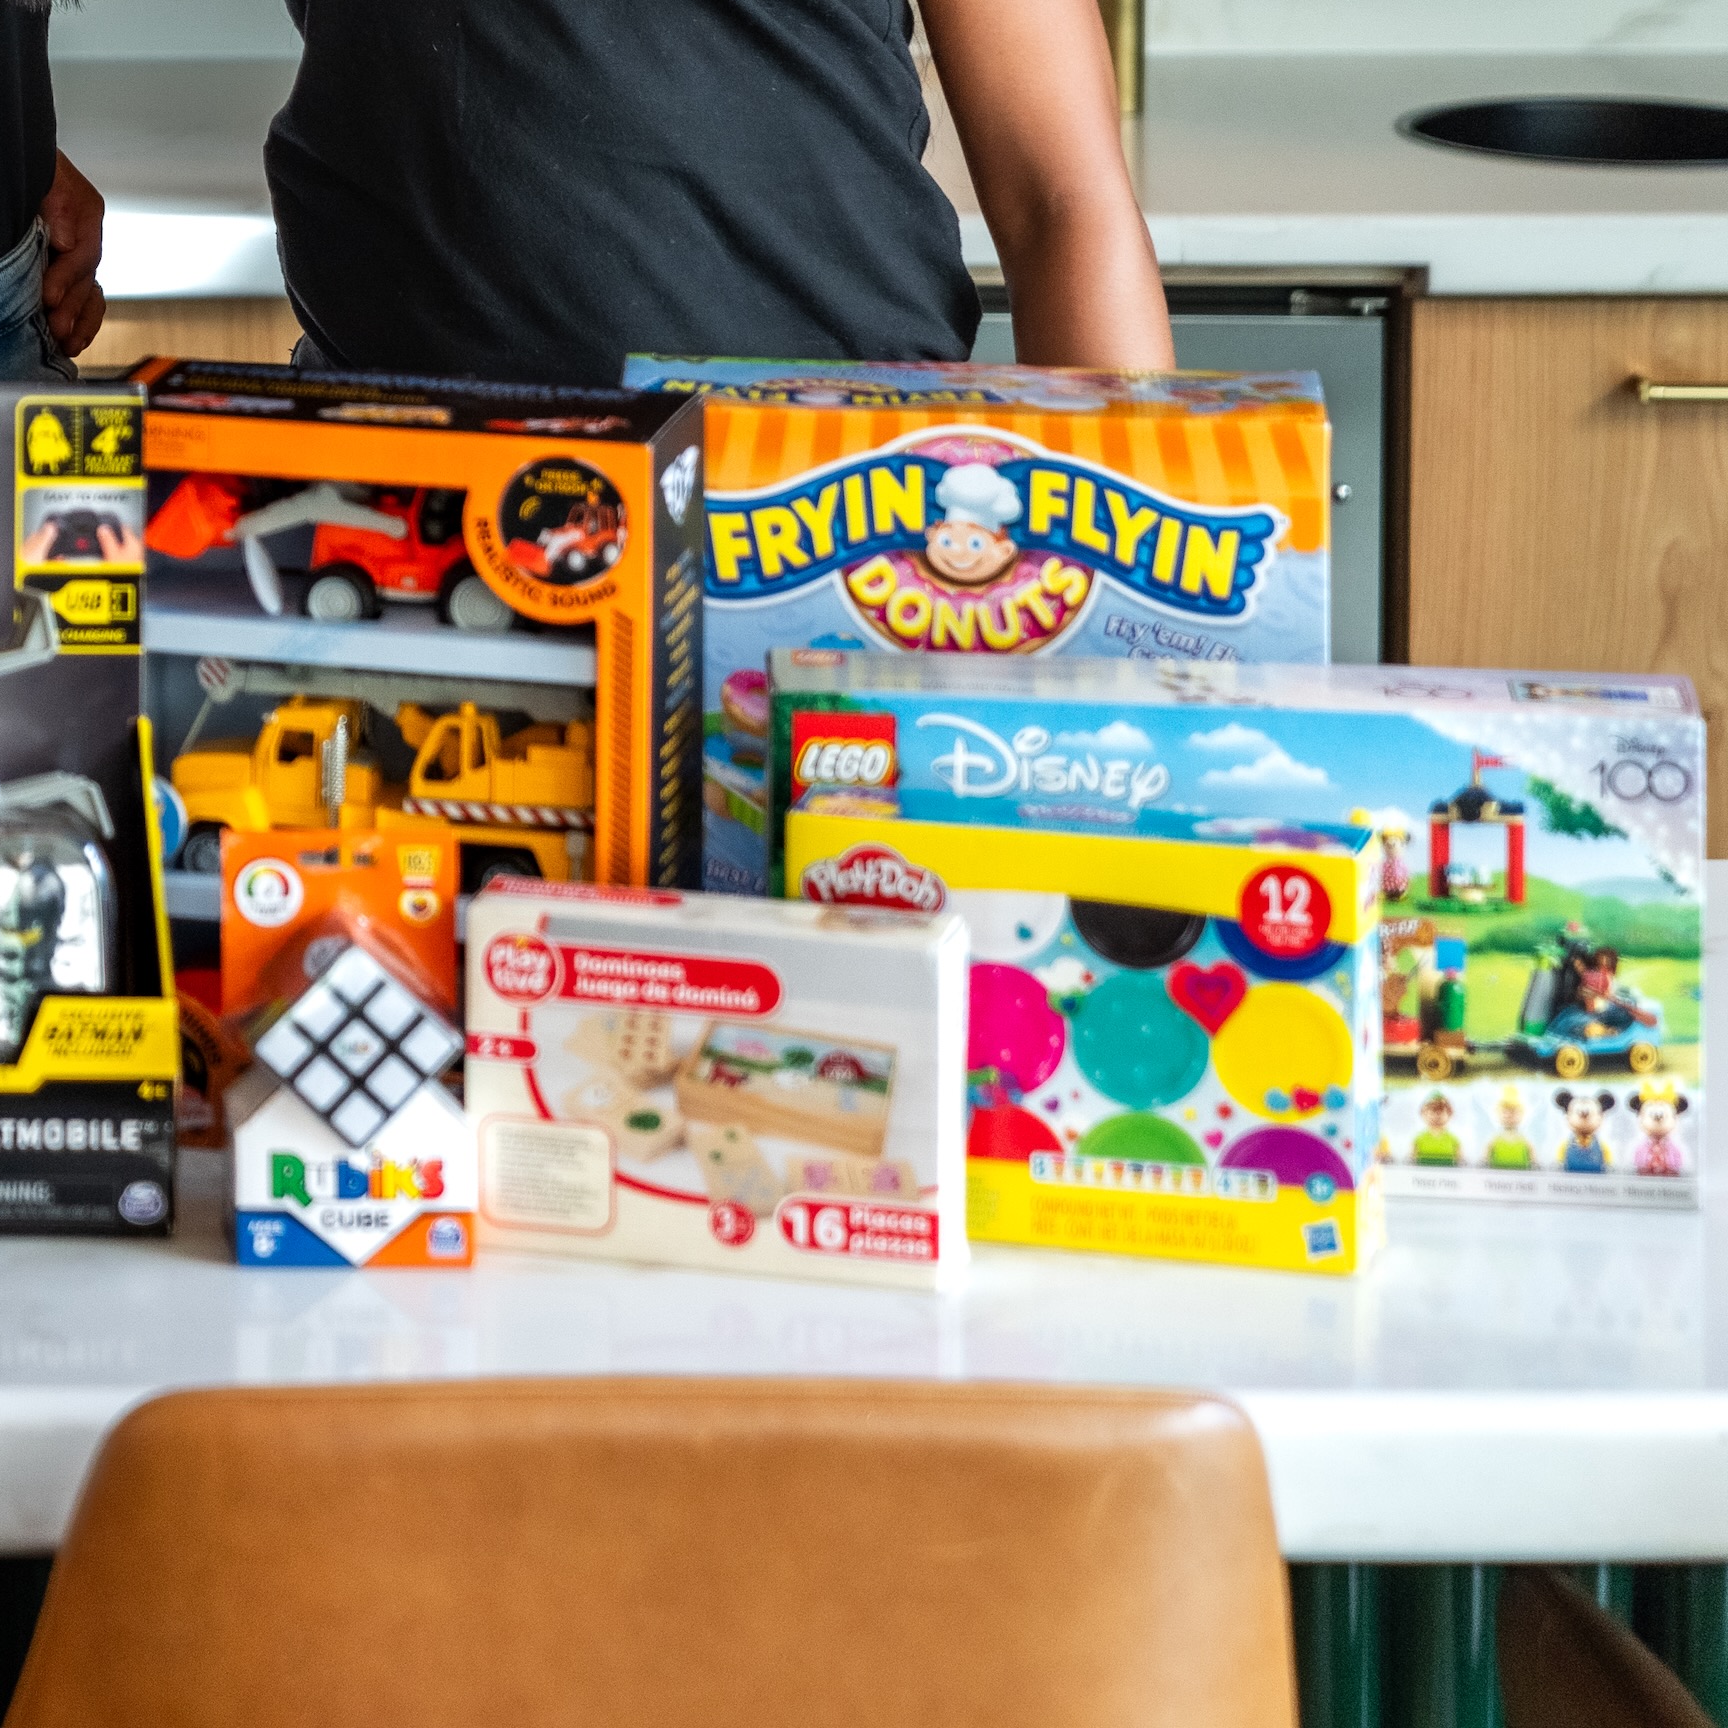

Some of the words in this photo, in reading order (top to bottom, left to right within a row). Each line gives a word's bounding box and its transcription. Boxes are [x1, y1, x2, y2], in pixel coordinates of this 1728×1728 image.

[709, 465, 925, 583] FRYIN
[1028, 469, 1239, 601] FLYIN
[476, 518, 542, 602] REALISTIC
[847, 553, 1091, 651] DONUTS
[1104, 613, 1150, 646] Fry
[798, 741, 892, 784] LEGO
[916, 712, 1171, 809] Disney
[1589, 759, 1695, 803] 100
[1259, 874, 1313, 925] 12
[488, 942, 550, 972] Play
[573, 951, 685, 982] Dominoes
[573, 974, 638, 1001] Juego
[641, 980, 668, 1001] de
[319, 1208, 391, 1229] CUBE
[781, 1204, 845, 1250] 16
